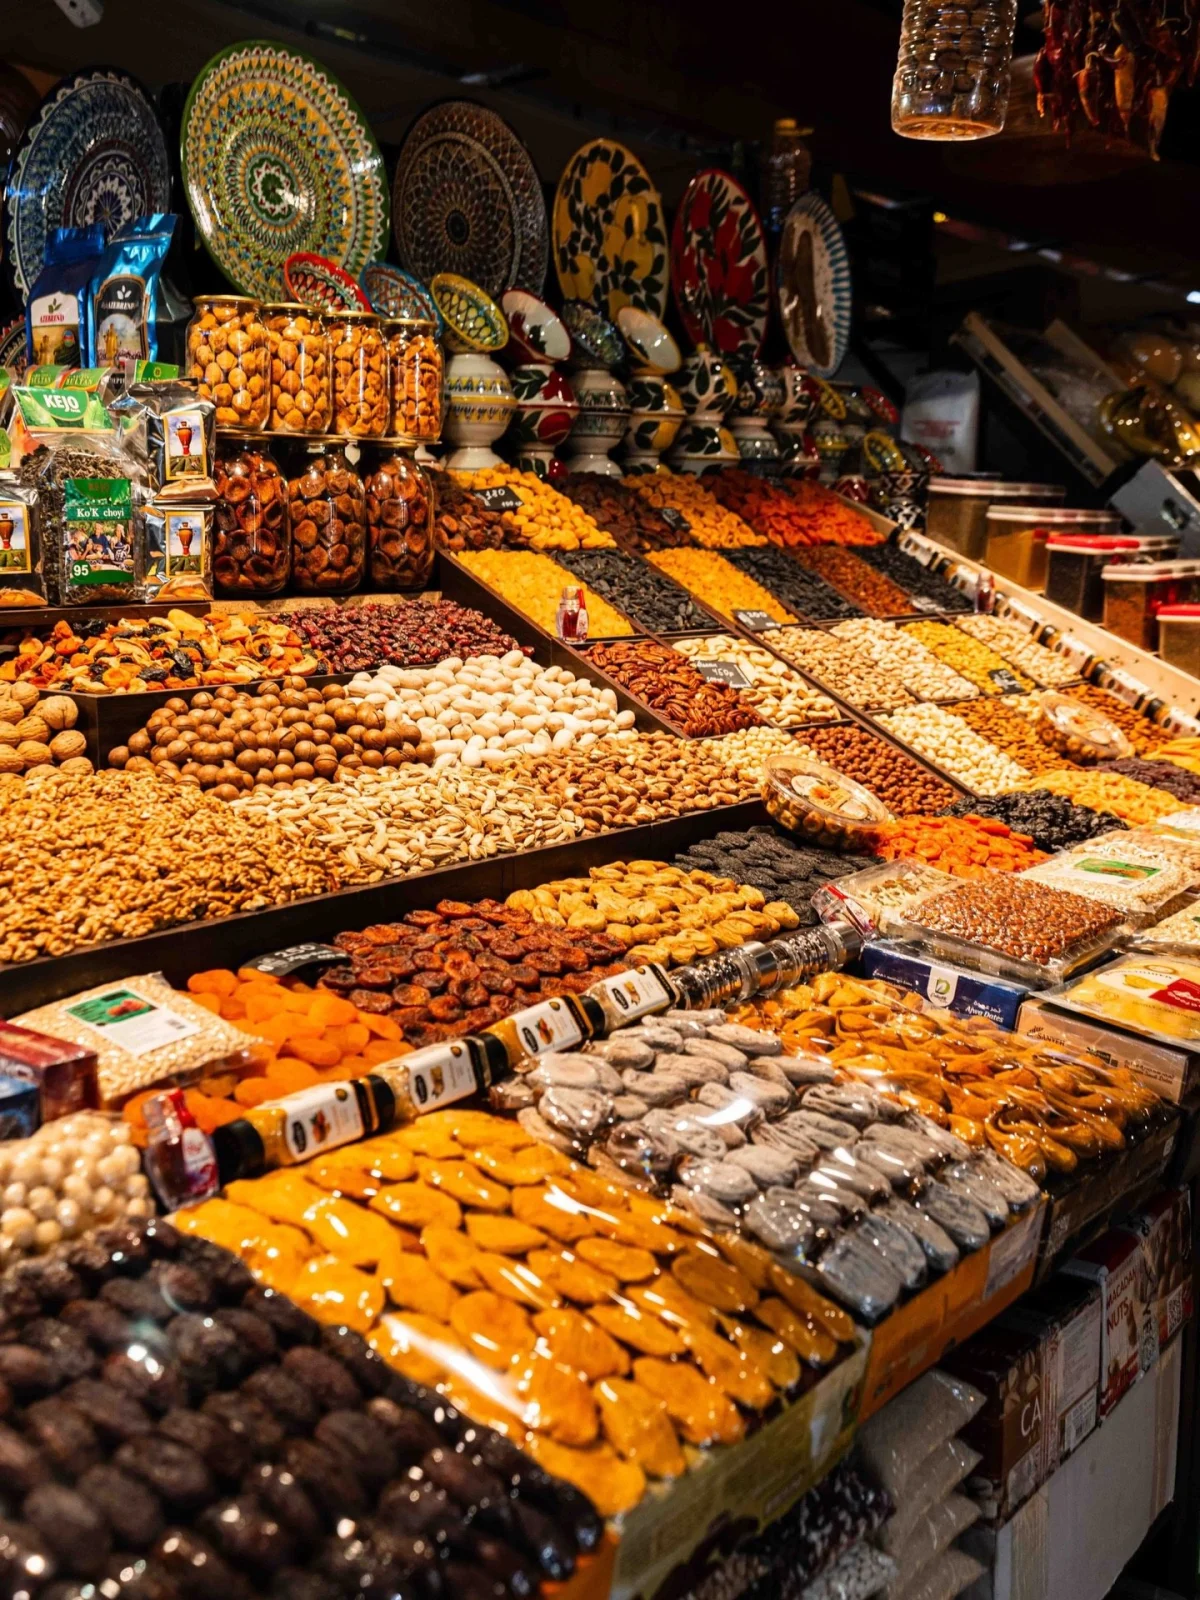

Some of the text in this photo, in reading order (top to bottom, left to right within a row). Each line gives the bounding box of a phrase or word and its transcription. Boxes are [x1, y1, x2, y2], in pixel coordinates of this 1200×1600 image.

[43, 394, 80, 412] KEJO
[103, 508, 124, 519] choyi
[73, 564, 89, 576] 95
[984, 1010, 1004, 1023] Dates
[1107, 1296, 1129, 1336] NUTS
